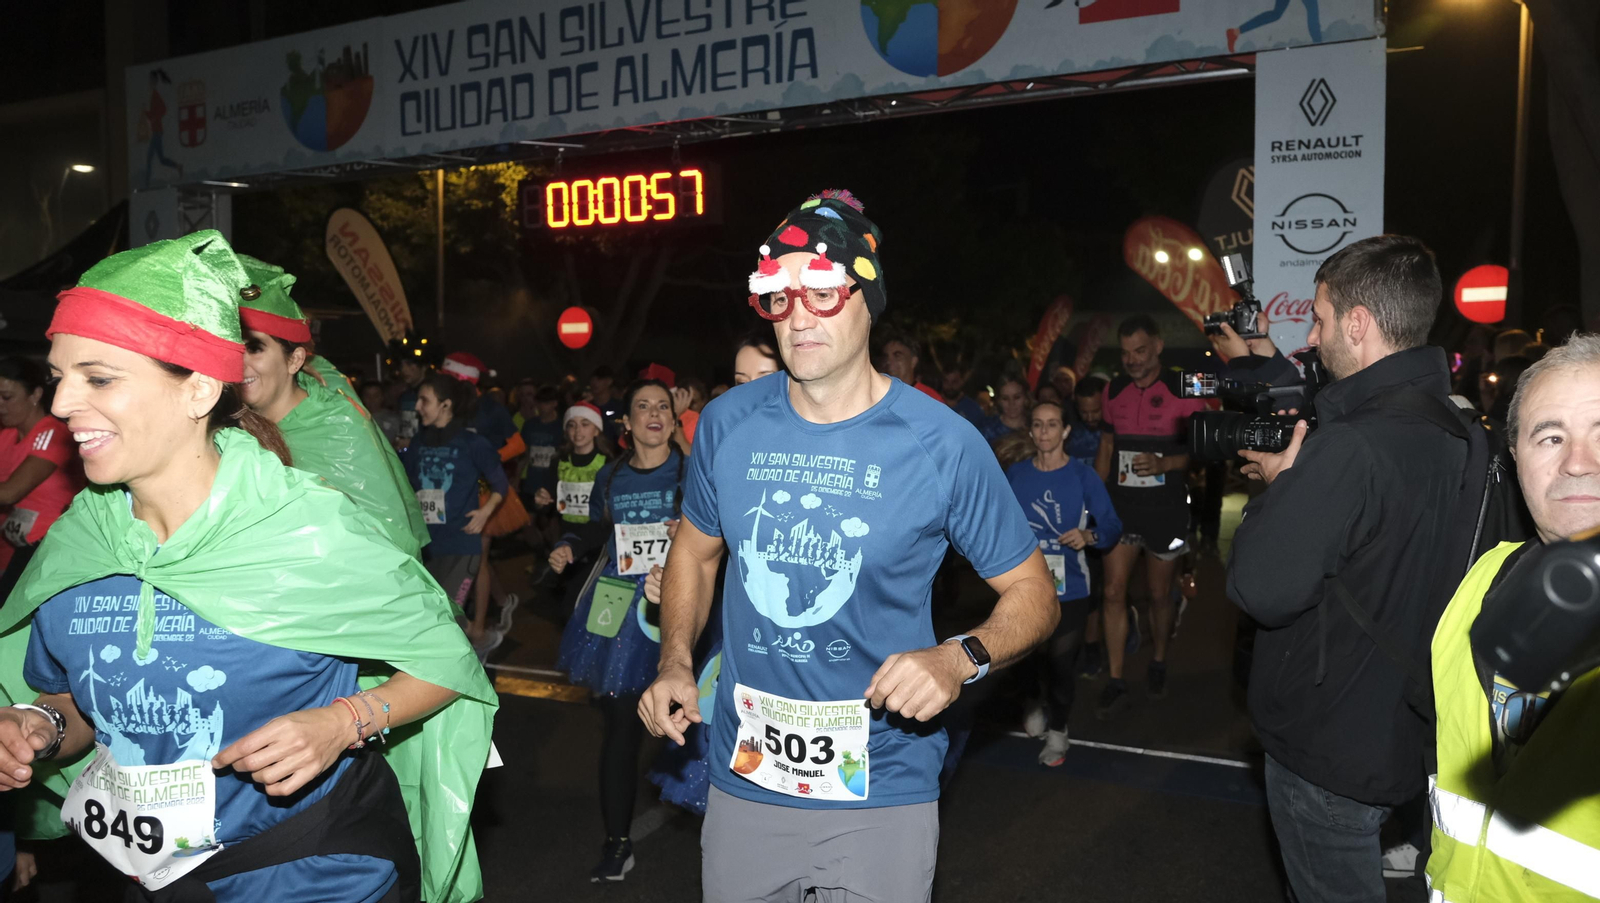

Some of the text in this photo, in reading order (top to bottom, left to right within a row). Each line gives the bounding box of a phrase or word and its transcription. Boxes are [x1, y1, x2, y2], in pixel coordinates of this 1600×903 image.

[394, 30, 455, 83] XIV
[466, 13, 546, 72] SAN
[400, 20, 818, 137] CIUDAD DE ALMERÍA
[1271, 134, 1364, 152] RENAULT
[1271, 149, 1362, 163] SYRSA AUTOMOCION
[1271, 216, 1357, 231] NISSAN
[750, 451, 857, 474] XIV SAN SILVESTRE
[746, 467, 854, 489] CIUDAD DE ALMERÍA
[565, 493, 589, 504] 412
[633, 539, 668, 555] 577
[73, 596, 90, 613] XIV
[92, 595, 120, 613] SAN
[68, 612, 195, 635] CIUDAD DE MERÍA
[199, 627, 233, 635] ALMER
[758, 695, 861, 717] XIV SAN SILVESTRE
[761, 706, 794, 726] CIUDAD
[797, 716, 811, 728] DE
[765, 724, 835, 765] 503
[117, 765, 202, 788] SILVESTRE
[773, 759, 825, 778] JOSE MANUEL
[117, 785, 131, 802] DE
[186, 796, 206, 805] 2022
[84, 798, 164, 855] 849
